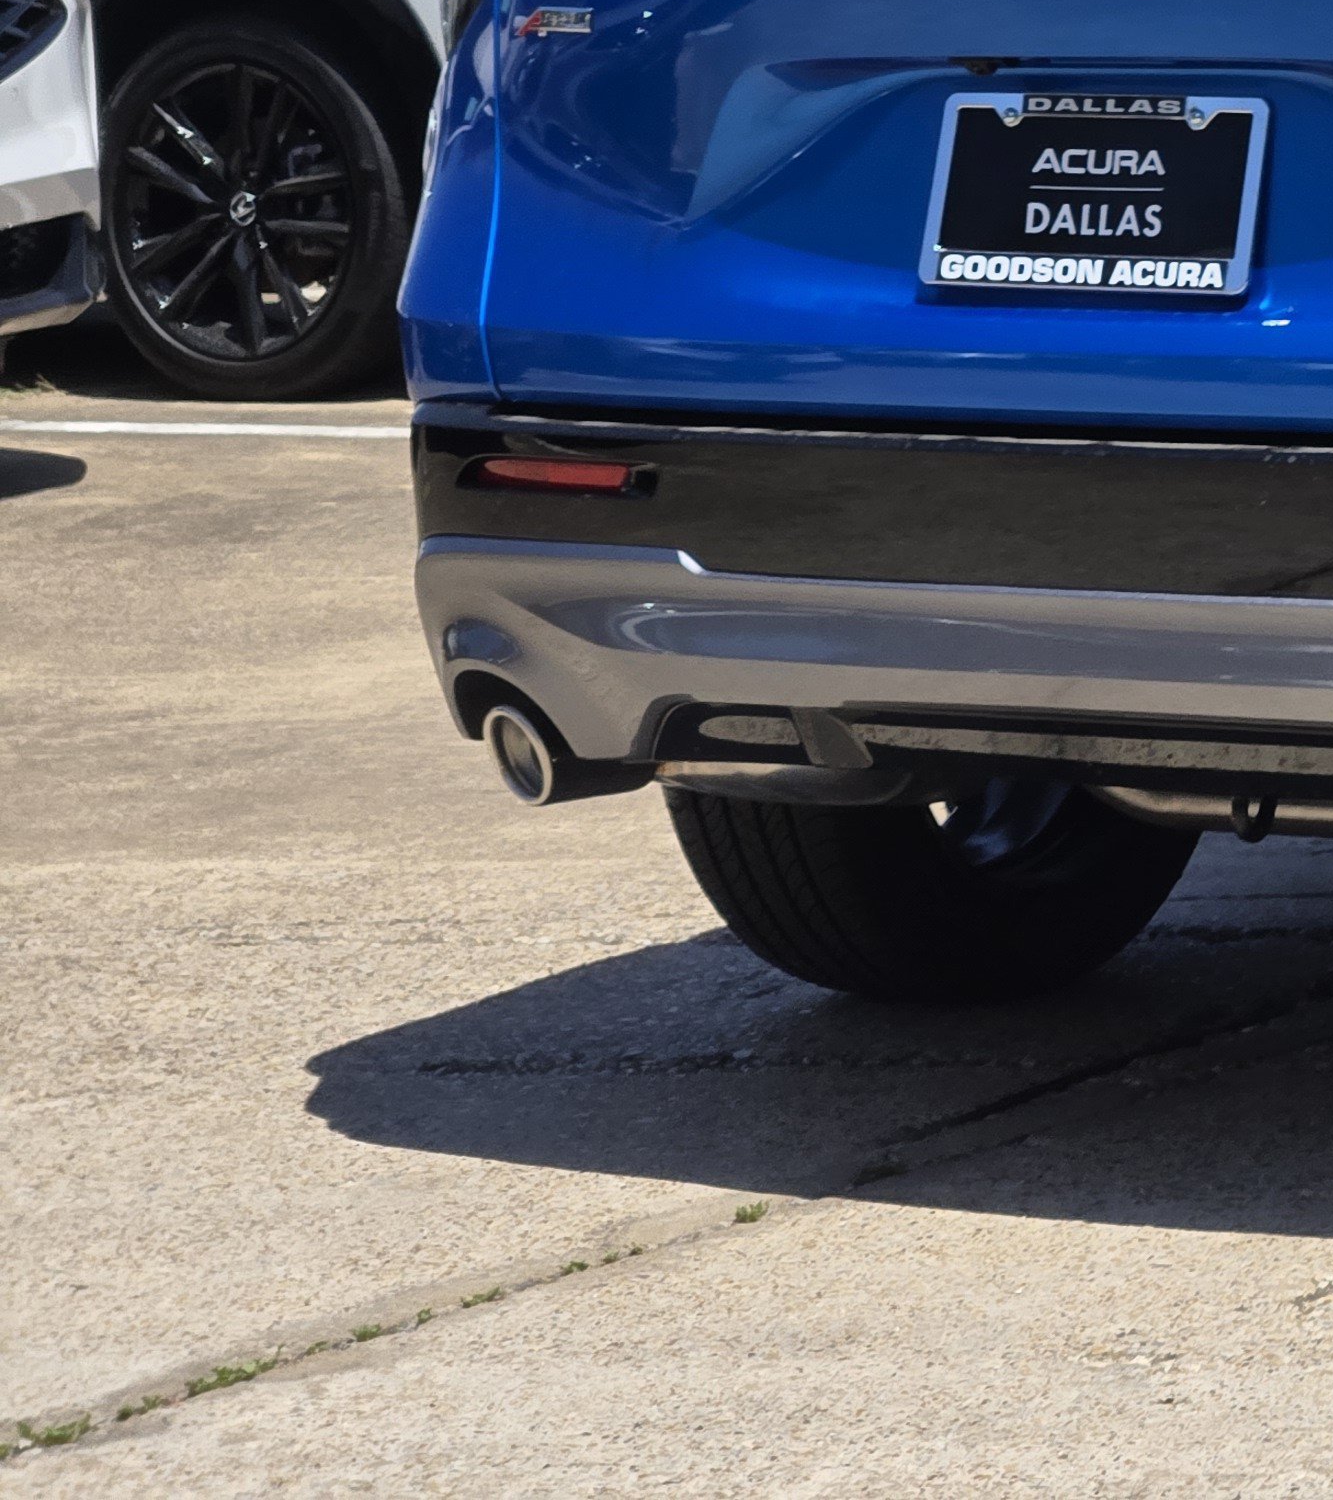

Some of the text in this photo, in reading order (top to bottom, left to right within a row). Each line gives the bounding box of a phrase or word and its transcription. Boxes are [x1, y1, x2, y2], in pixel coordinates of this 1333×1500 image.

[1027, 97, 1181, 114] DALLAS
[1031, 148, 1166, 176] ACURA
[1025, 202, 1162, 237] DALLAS
[940, 253, 1224, 288] GOODSON ACURA
